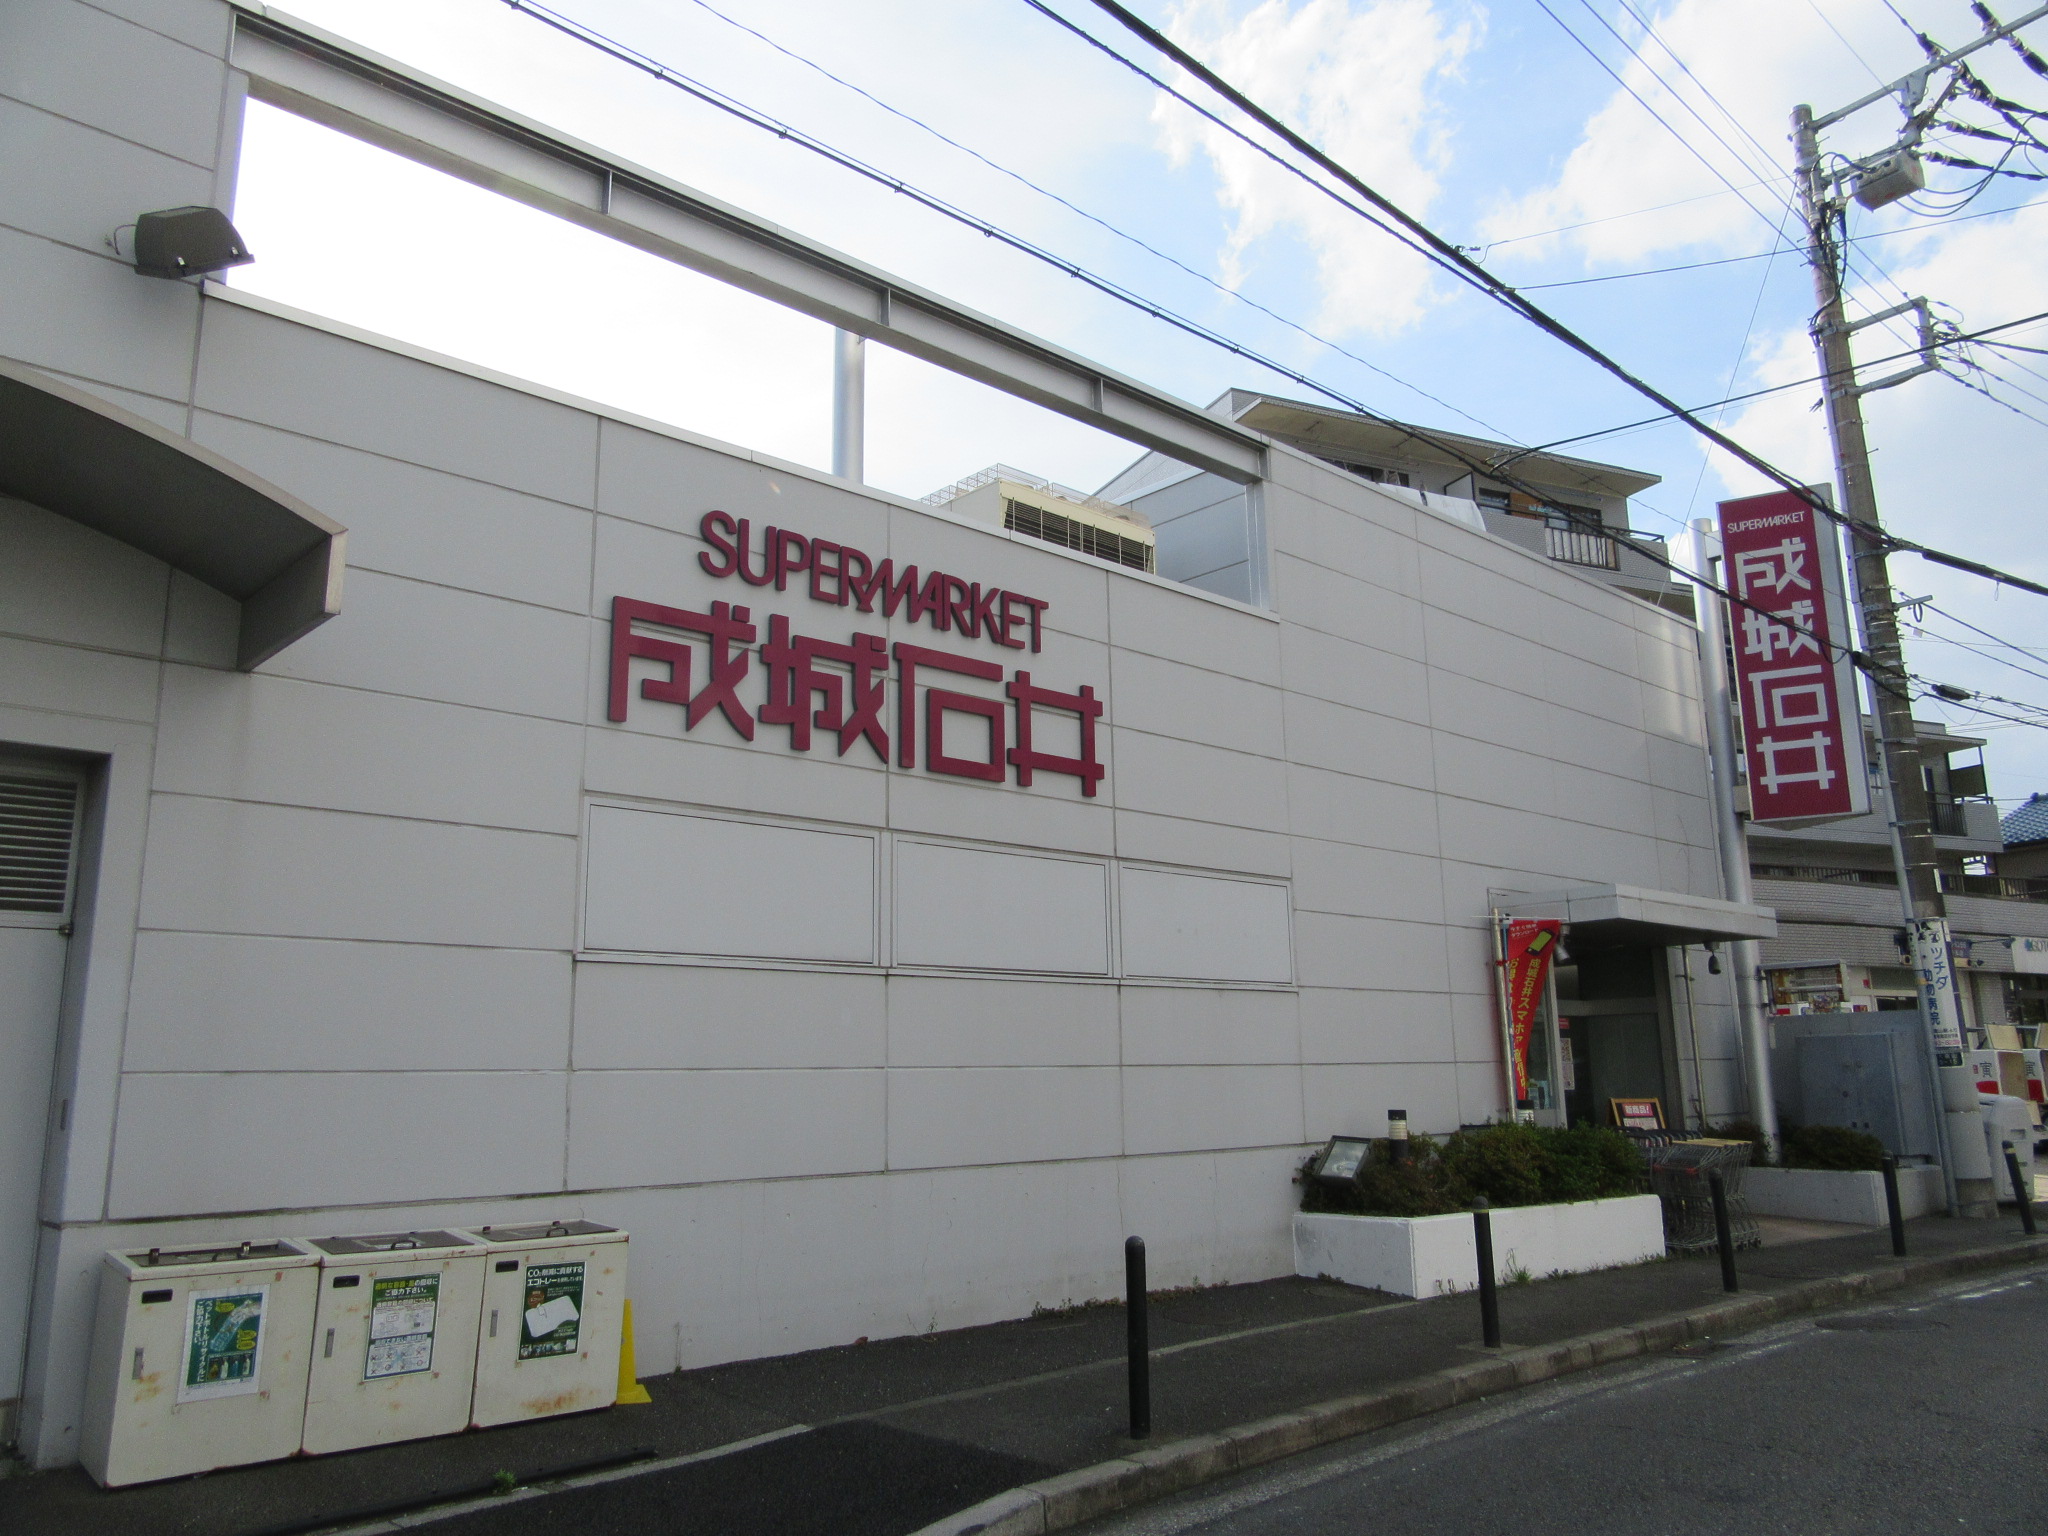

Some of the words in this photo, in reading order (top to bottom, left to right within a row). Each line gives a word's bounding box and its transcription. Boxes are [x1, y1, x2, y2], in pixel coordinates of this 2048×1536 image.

[699, 510, 1049, 653] SUPERMARKET
[1727, 511, 1805, 534] SUPERMARKET
[607, 595, 1104, 797] 成城石井
[1734, 537, 1835, 794] 成城石井
[1931, 946, 1949, 990] ツチダ
